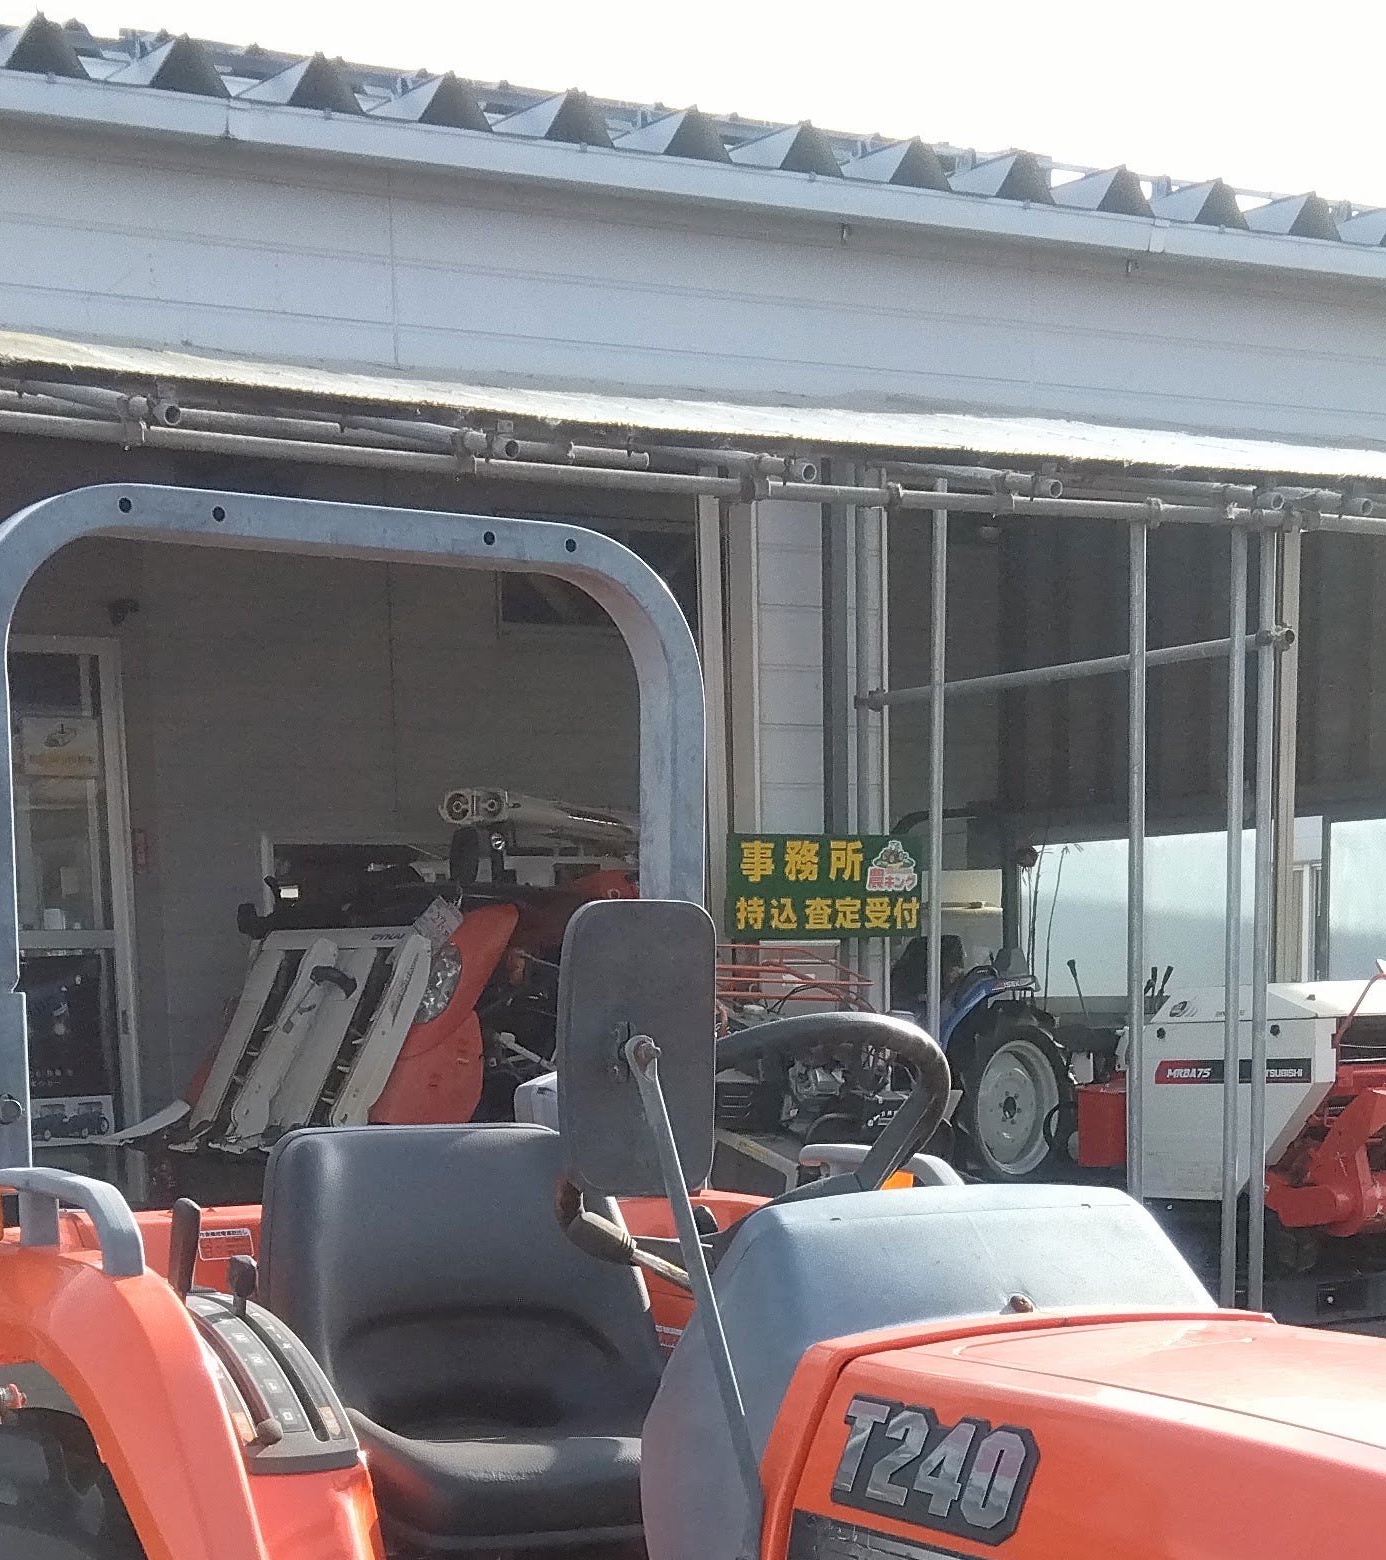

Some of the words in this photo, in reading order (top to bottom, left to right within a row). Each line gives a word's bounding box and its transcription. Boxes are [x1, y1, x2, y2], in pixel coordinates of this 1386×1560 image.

[740, 839, 865, 883] 事務所
[833, 1399, 1027, 1530] T240
